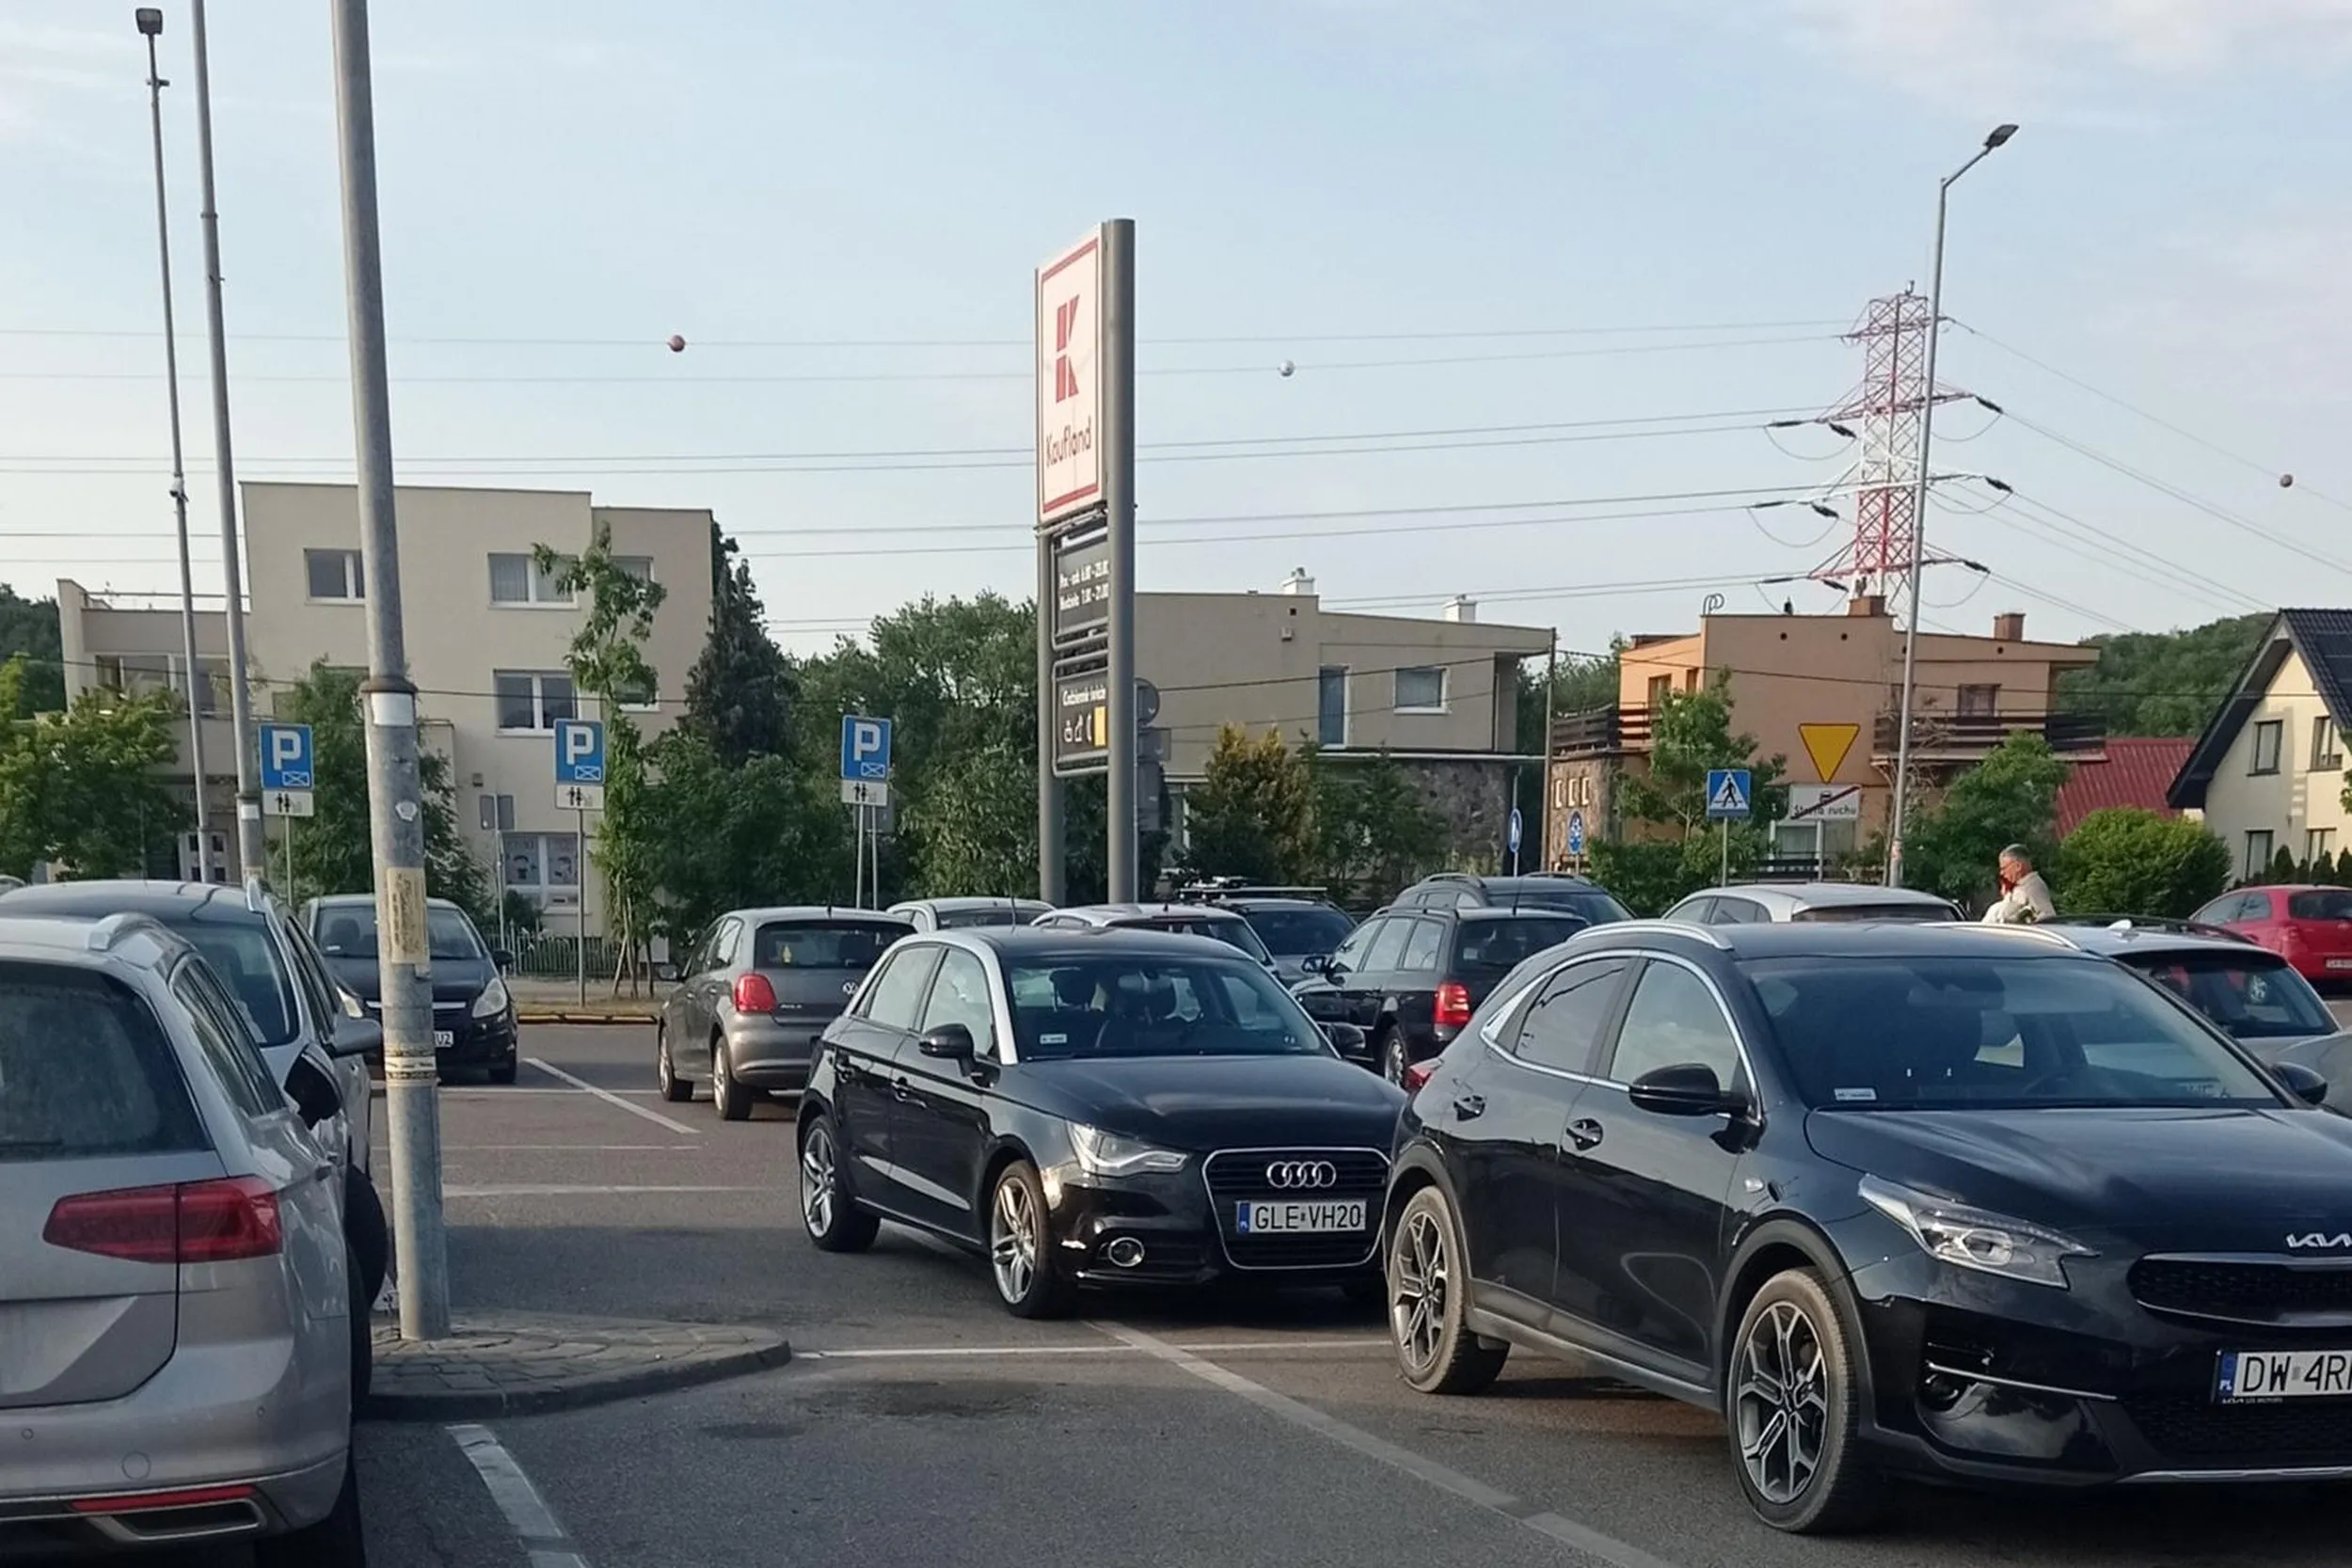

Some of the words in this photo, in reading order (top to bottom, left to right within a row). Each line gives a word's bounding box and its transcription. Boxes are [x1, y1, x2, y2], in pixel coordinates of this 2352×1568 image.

[1055, 293, 1080, 404] K
[1045, 415, 1091, 467] Kaufland
[272, 730, 301, 770] P
[566, 725, 594, 765] P
[853, 722, 881, 761] P
[1828, 804, 1857, 816] ruchu
[1255, 1205, 1299, 1230] GLE
[1309, 1204, 1361, 1229] VH20
[2242, 1355, 2292, 1392] DW
[2303, 1354, 2352, 1391] 4R
